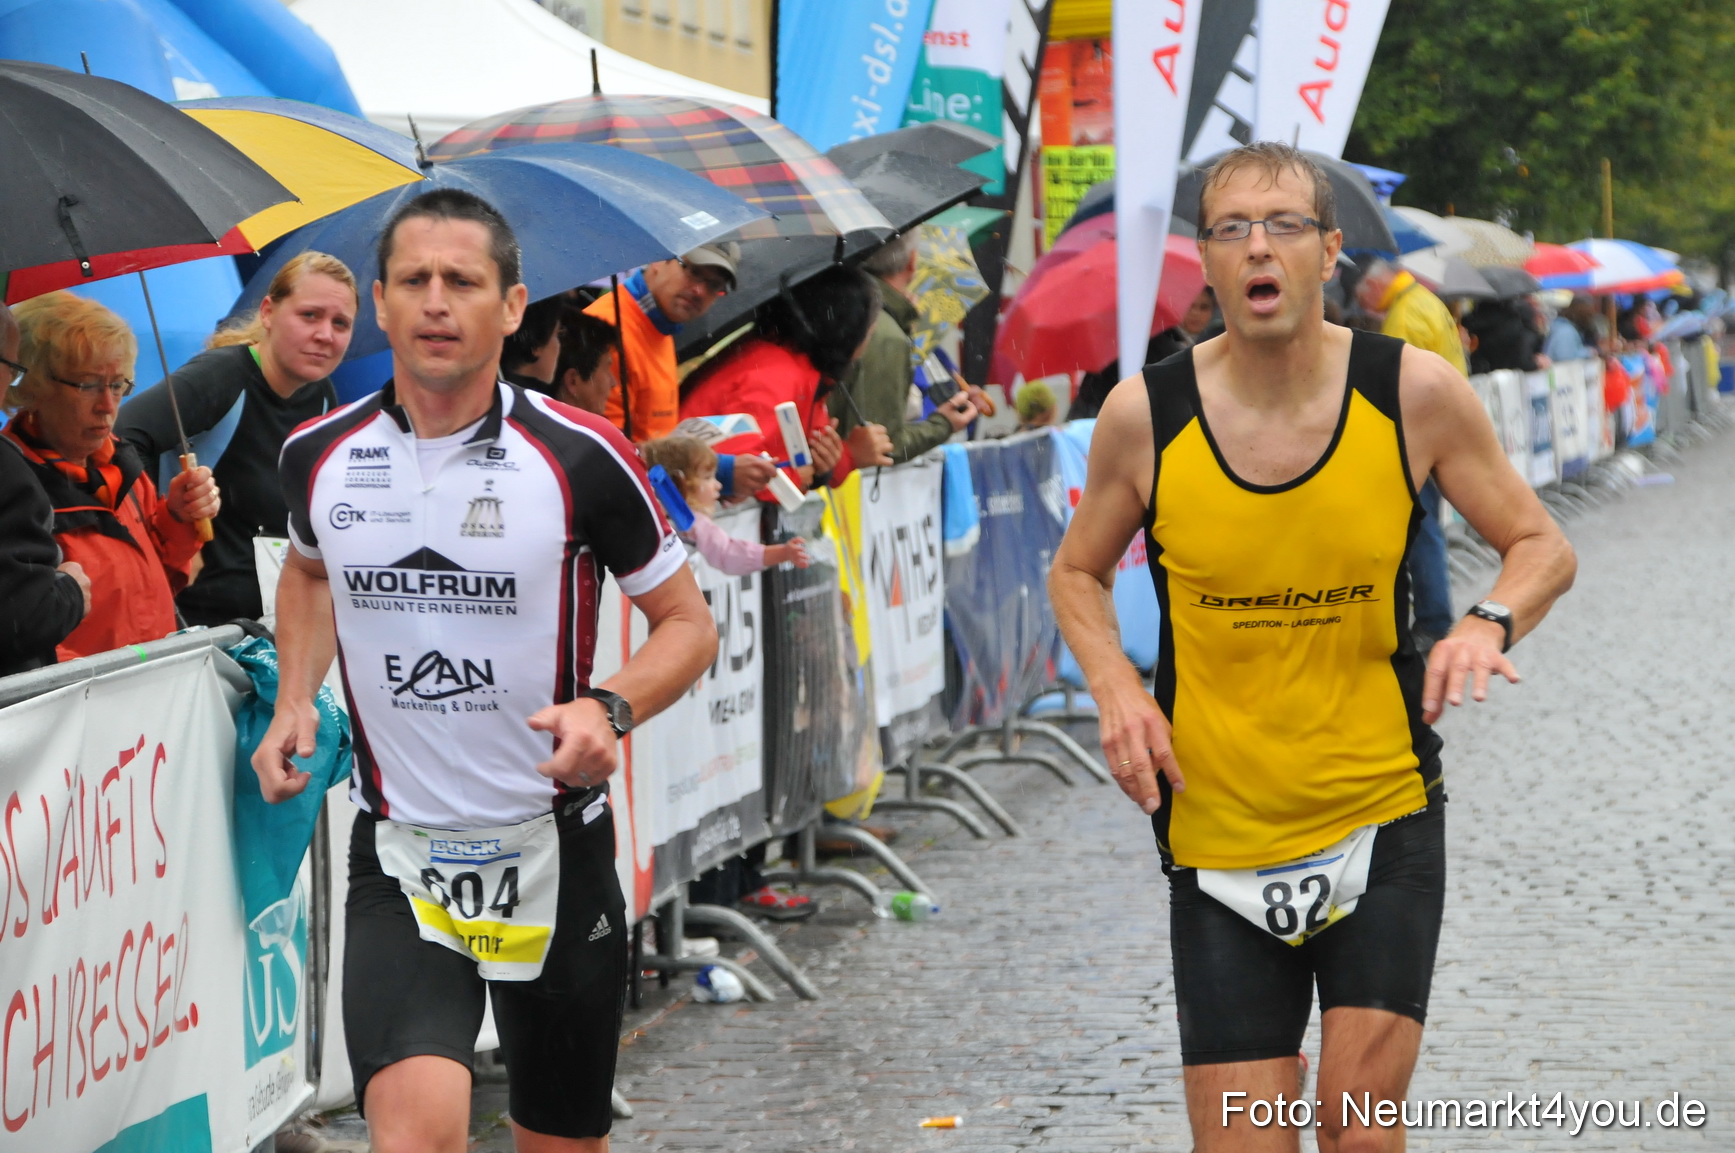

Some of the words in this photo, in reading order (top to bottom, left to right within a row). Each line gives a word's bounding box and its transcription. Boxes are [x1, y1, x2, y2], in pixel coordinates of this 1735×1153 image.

[349, 446, 390, 460] FRANK
[343, 570, 517, 598] WOLFRUM
[351, 598, 517, 616] BAUUNTERNEHMEN
[1232, 619, 1283, 630] SPEDITION
[1291, 614, 1342, 628] LAGERUNG
[391, 697, 447, 714] Marketing
[451, 701, 460, 712] &
[465, 700, 500, 712] Druck
[430, 838, 501, 856] BOCK
[1262, 873, 1332, 937] 82
[588, 926, 612, 943] adidas
